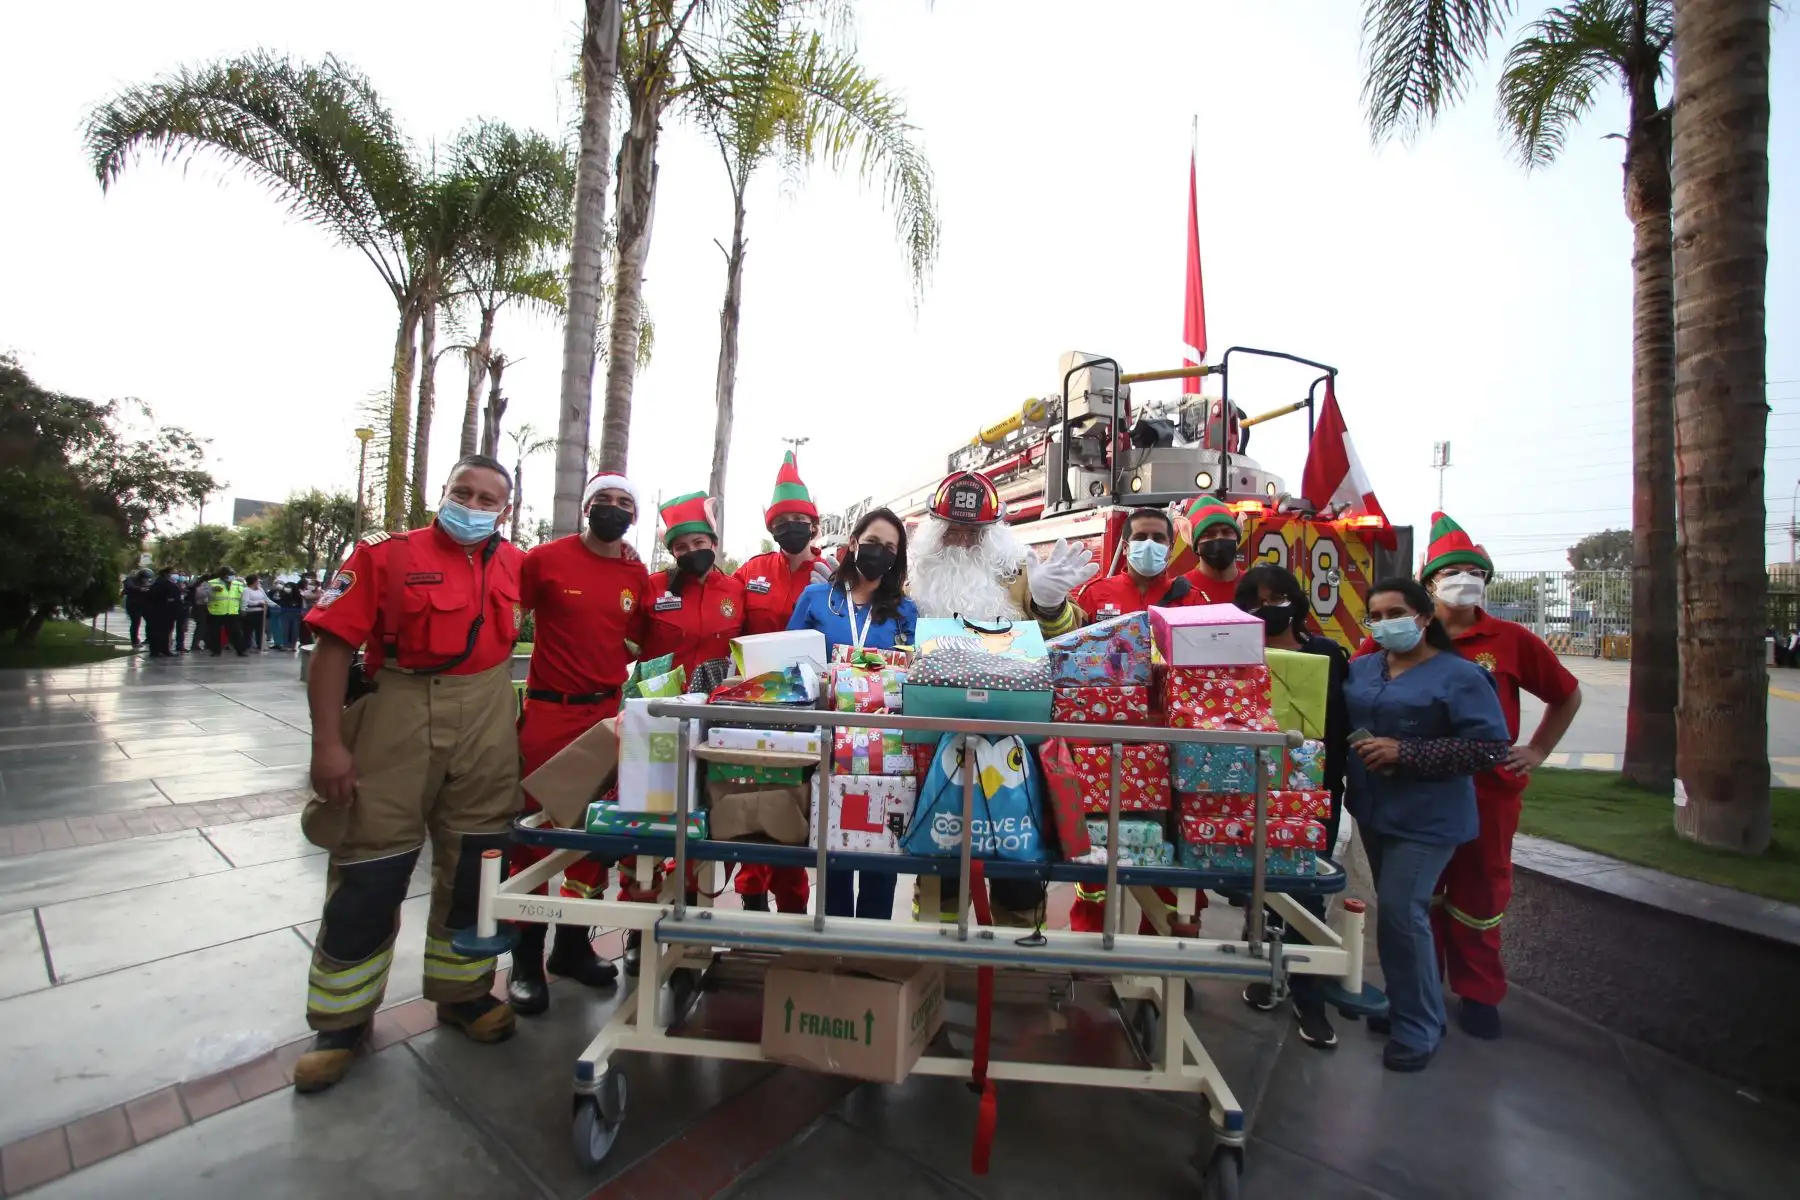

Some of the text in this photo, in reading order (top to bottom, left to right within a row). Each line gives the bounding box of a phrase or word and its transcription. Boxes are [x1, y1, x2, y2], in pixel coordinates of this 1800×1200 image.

[955, 491, 976, 508] 28
[971, 815, 1032, 835] GIVE A
[970, 832, 1033, 853] HOOT
[799, 1011, 859, 1042] FRAGIL
